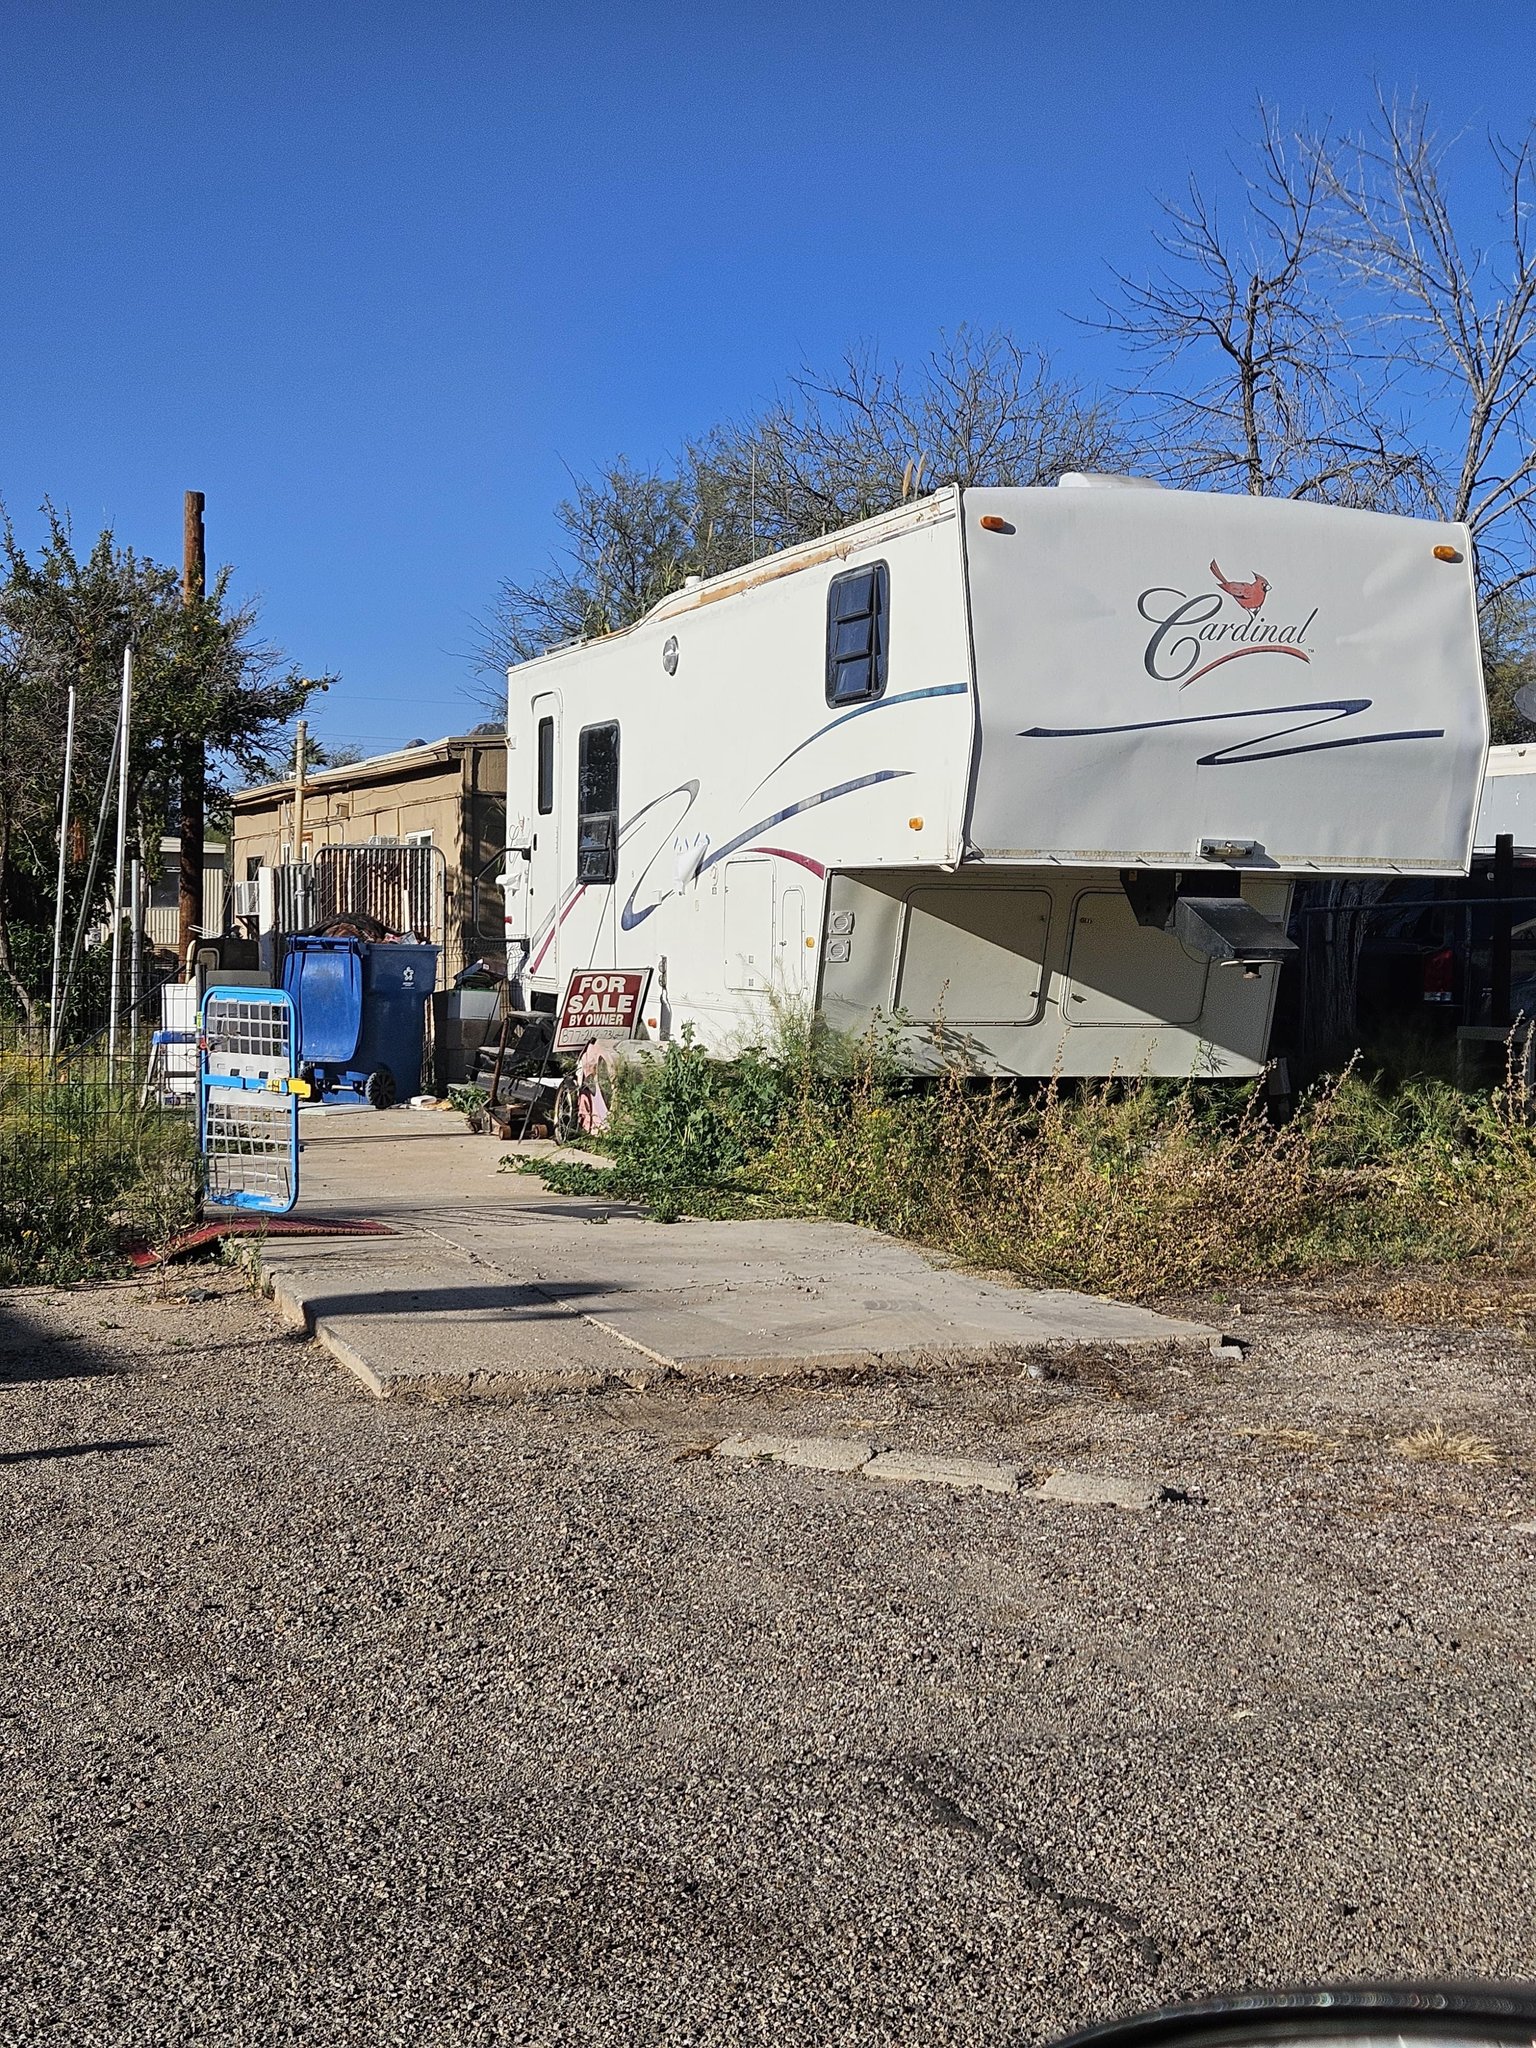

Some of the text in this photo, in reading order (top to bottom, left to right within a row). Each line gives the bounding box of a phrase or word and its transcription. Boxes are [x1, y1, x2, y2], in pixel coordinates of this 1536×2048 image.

[1137, 587, 1319, 681] Cardinal
[579, 976, 626, 994] FOR
[567, 994, 635, 1014] SALE
[569, 1014, 624, 1026] BY OWNER
